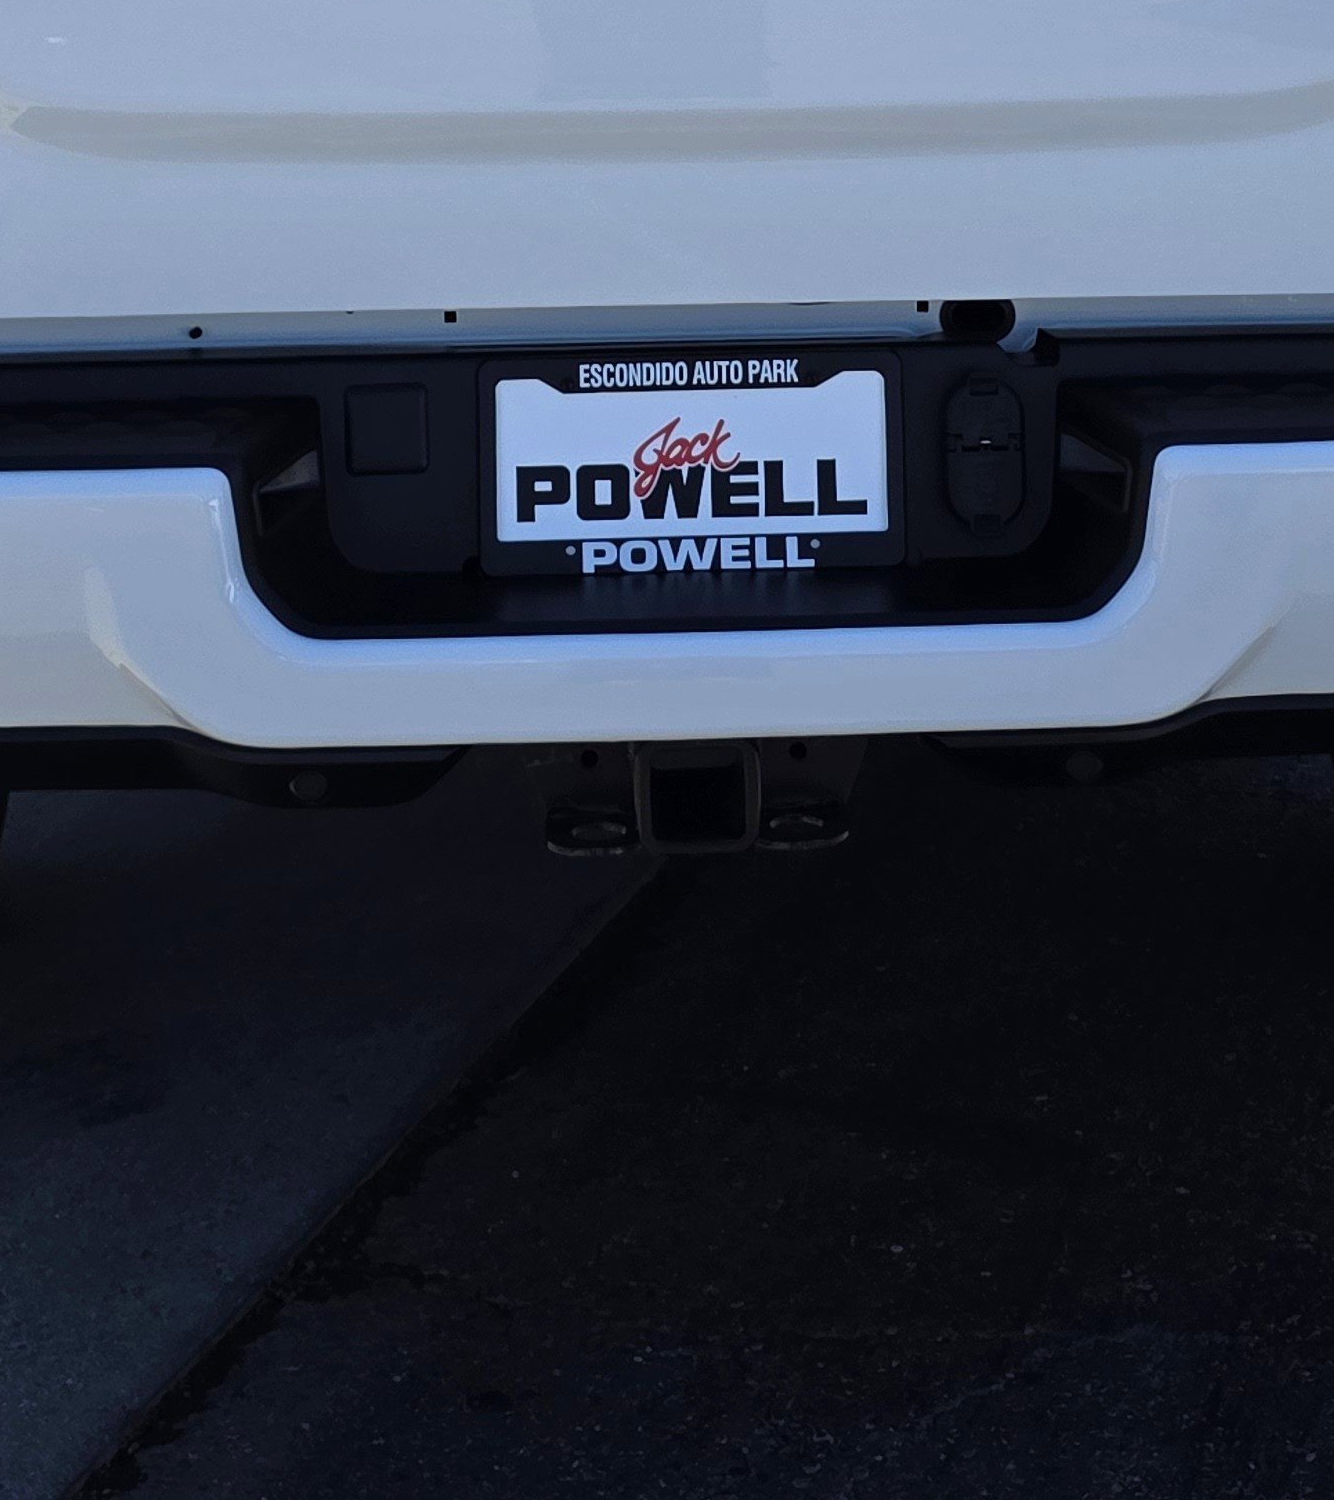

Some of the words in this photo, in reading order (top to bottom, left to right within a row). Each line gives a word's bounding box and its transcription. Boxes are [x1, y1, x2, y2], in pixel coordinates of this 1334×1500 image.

[579, 361, 688, 388] ESCONDIDO
[692, 360, 744, 386] AUTO
[747, 359, 799, 383] PARK
[633, 417, 740, 499] Jack
[516, 458, 868, 523] POWELL
[581, 536, 816, 574] POWELL
